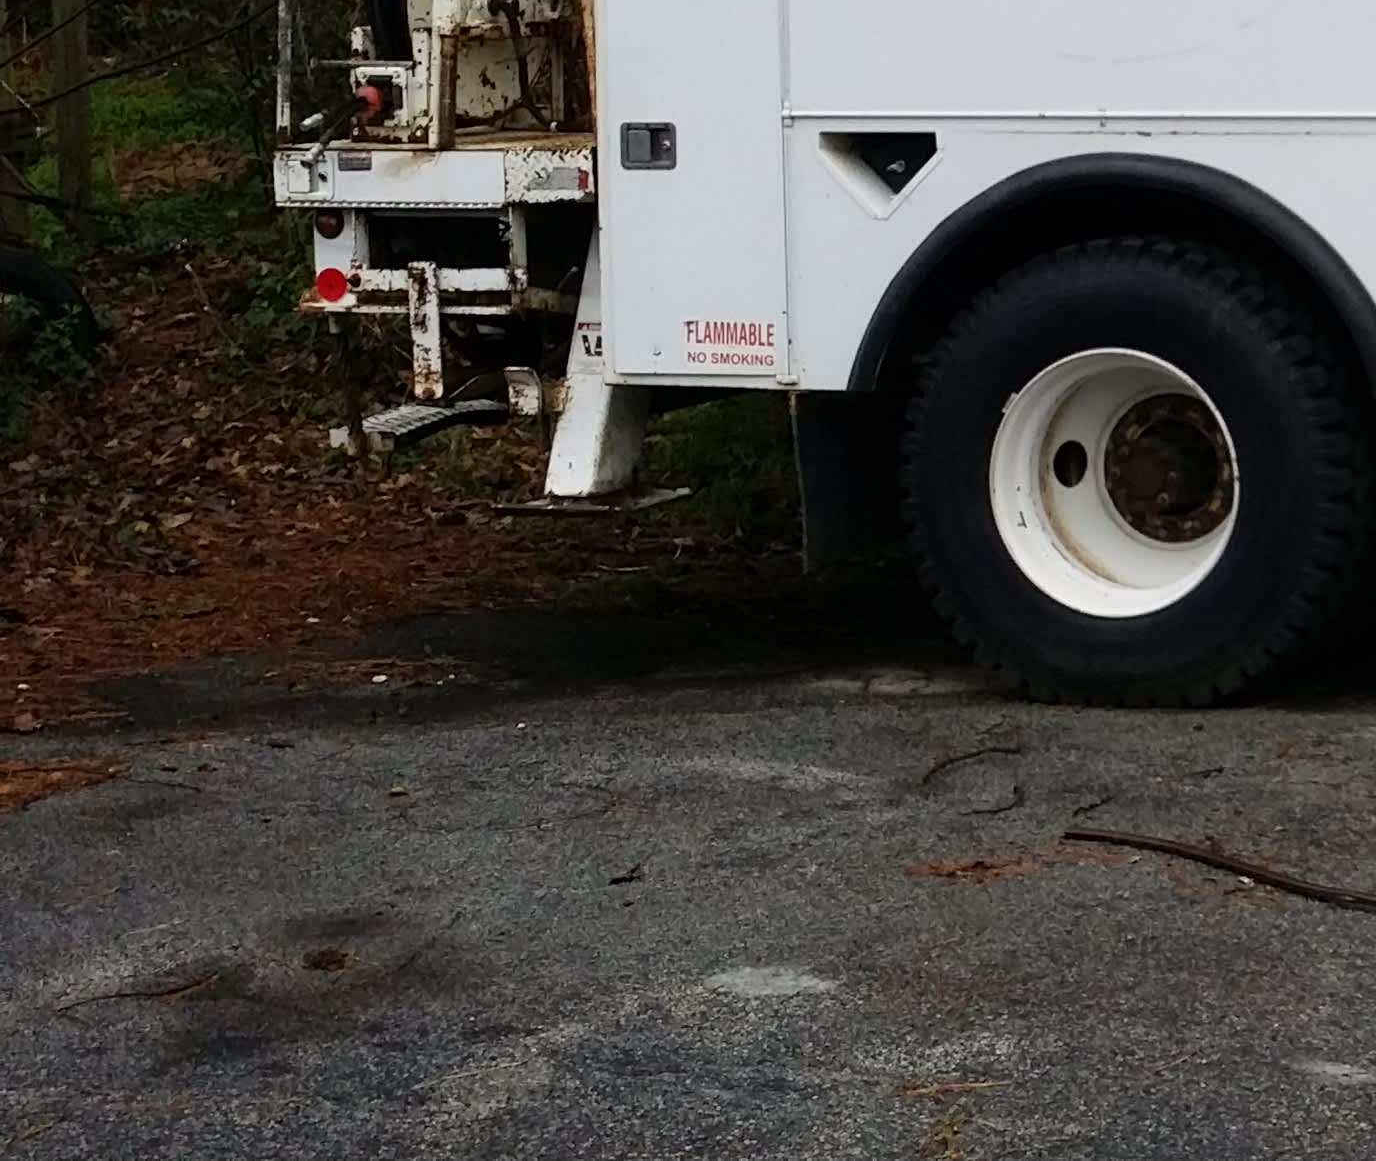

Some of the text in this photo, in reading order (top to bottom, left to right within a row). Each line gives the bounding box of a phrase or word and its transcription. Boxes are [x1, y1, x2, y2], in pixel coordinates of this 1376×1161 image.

[685, 320, 775, 347] FLAMMABLE
[687, 351, 775, 367] NO SMOKING
